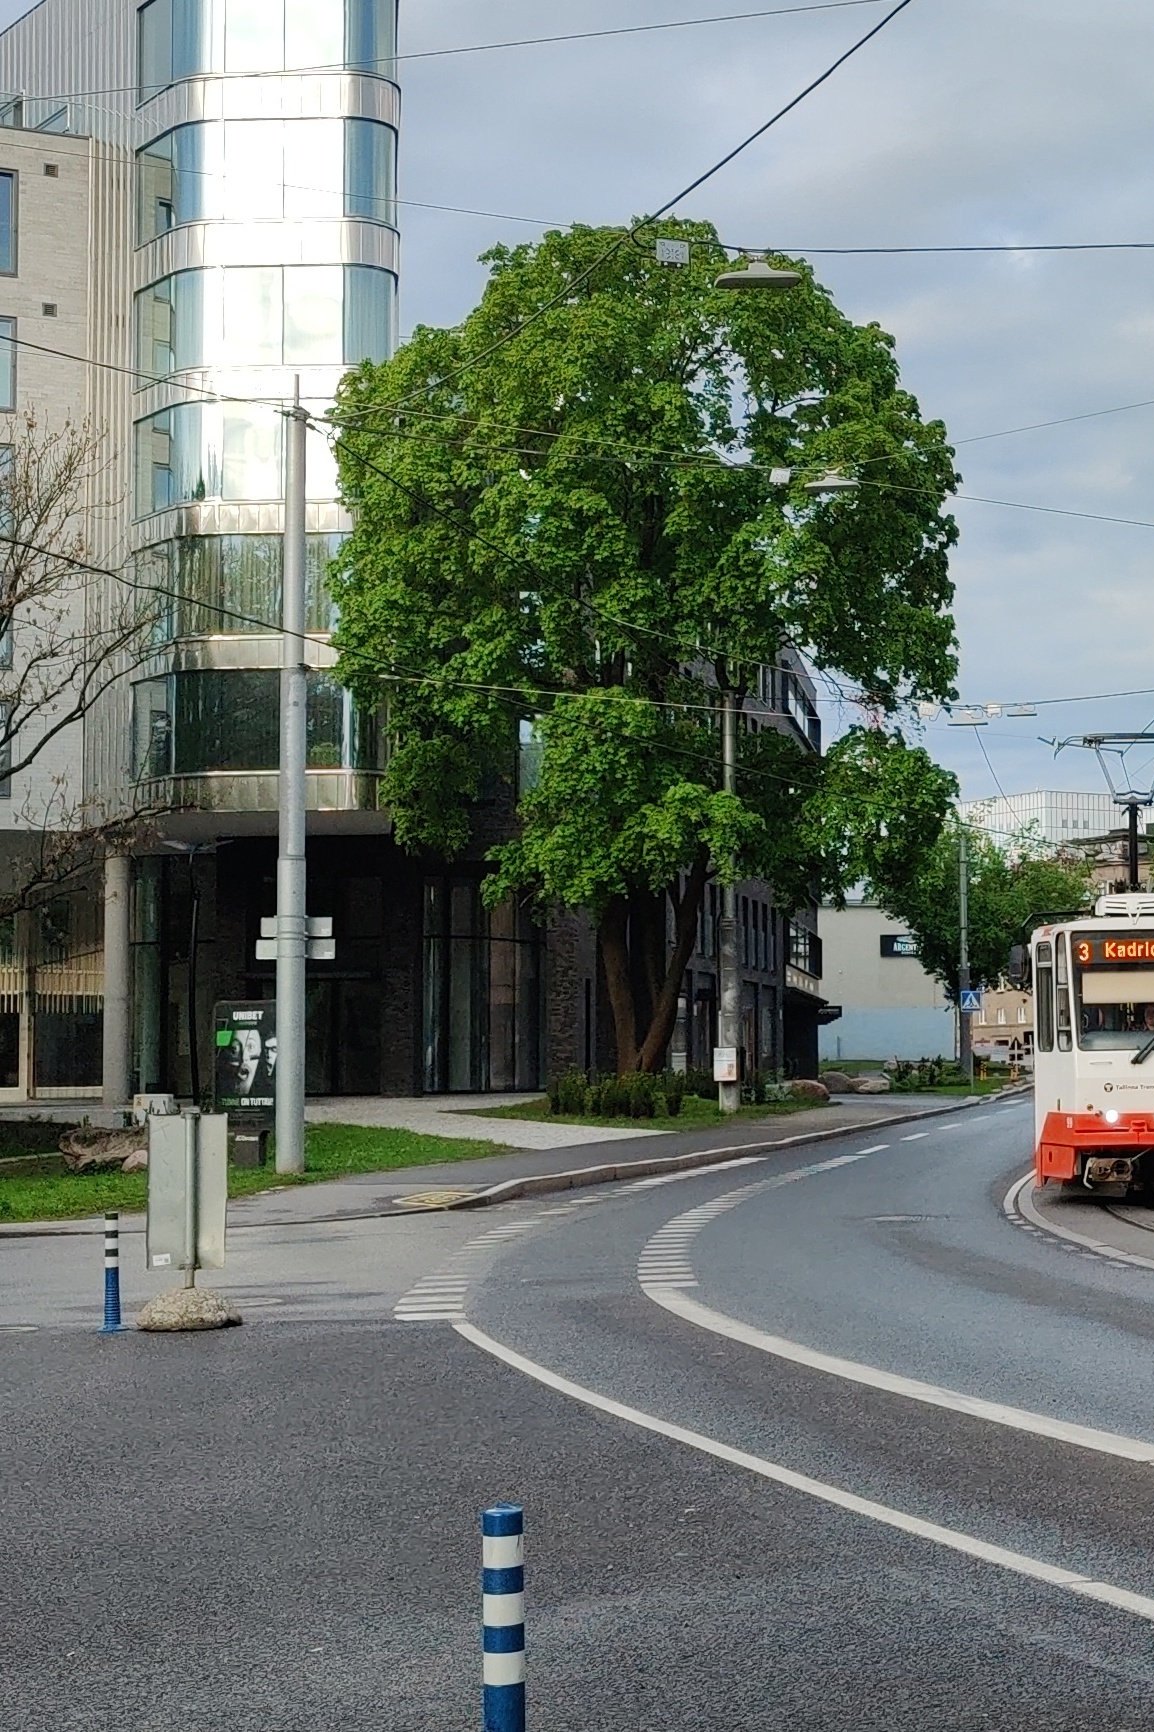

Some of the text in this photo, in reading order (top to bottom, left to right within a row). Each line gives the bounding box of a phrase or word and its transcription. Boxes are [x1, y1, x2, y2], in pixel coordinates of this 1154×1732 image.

[893, 942, 919, 951] ARGENT
[1079, 943, 1089, 961] 3
[233, 1010, 264, 1020] UNIBET
